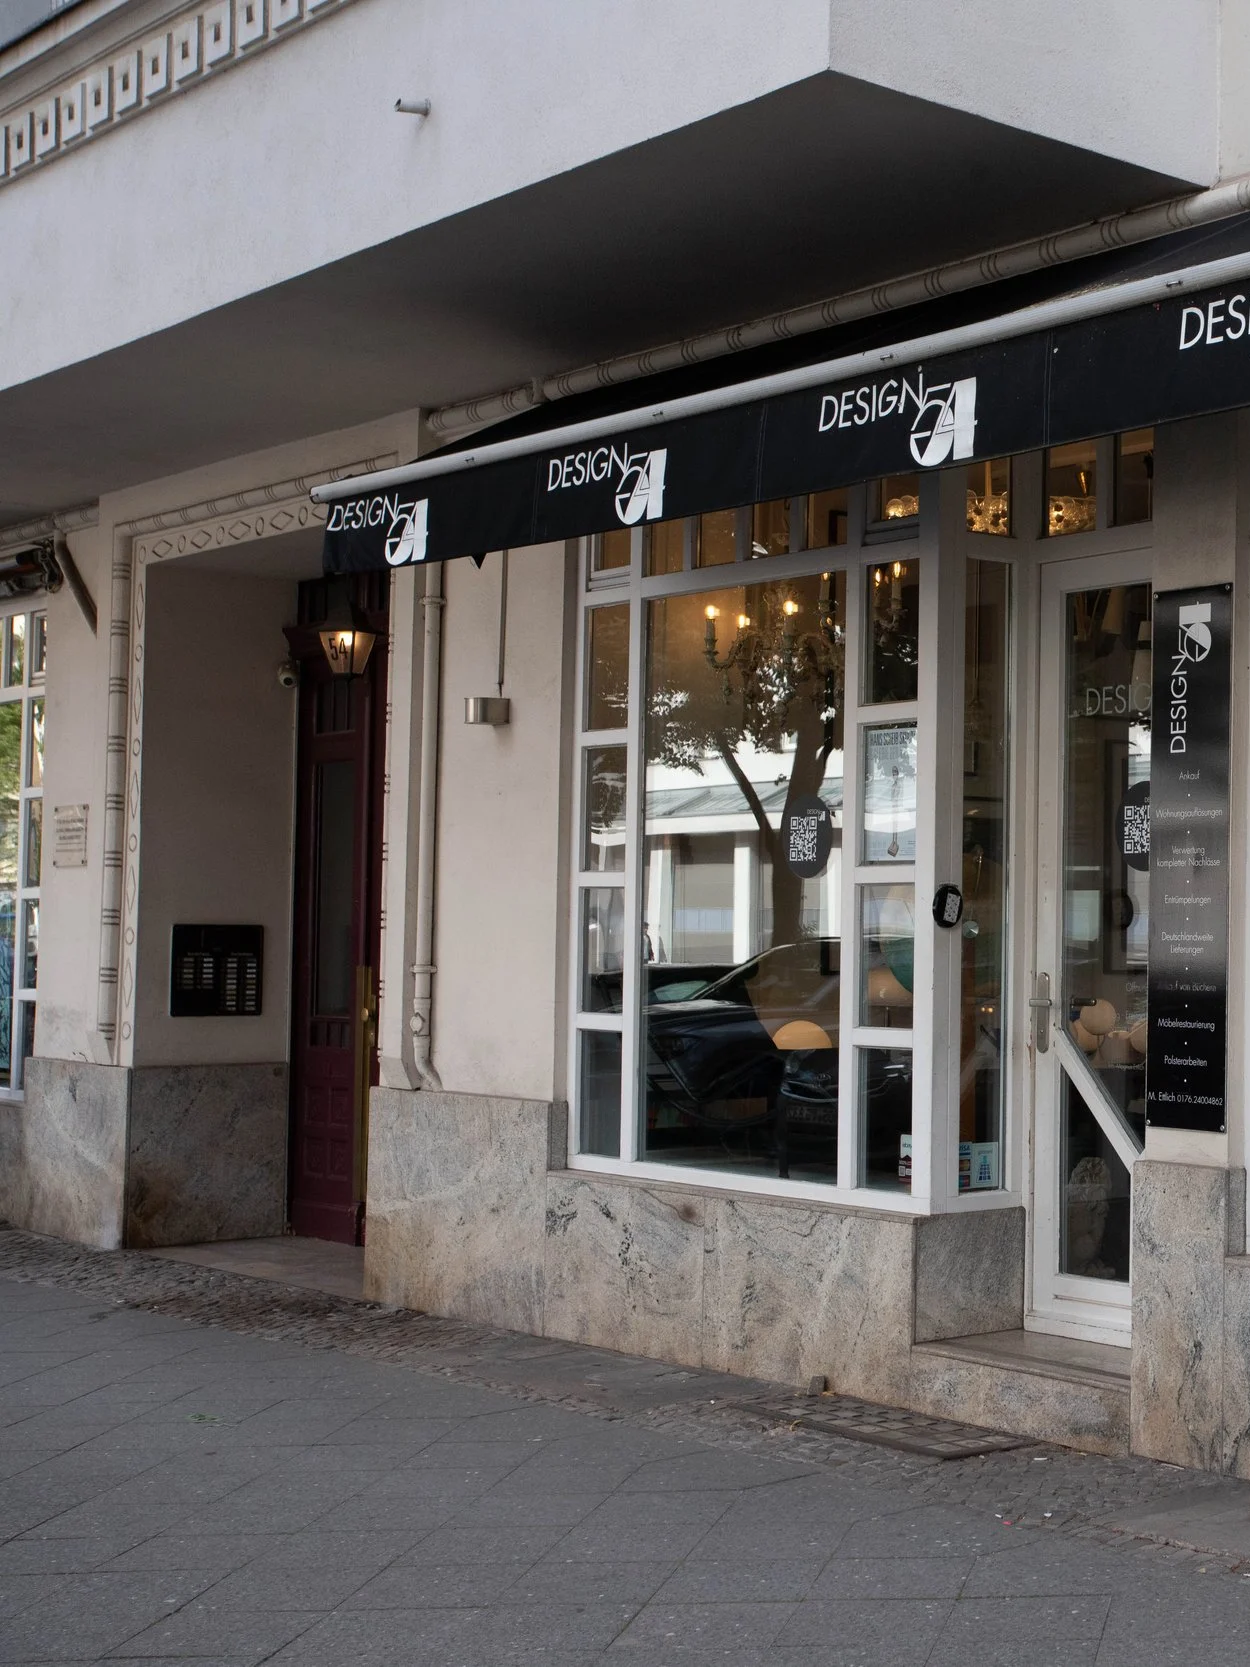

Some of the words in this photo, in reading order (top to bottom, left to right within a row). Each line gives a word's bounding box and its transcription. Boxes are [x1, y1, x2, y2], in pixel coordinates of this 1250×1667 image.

[818, 373, 923, 432] DESIGN
[909, 376, 978, 467] 54
[547, 442, 628, 492] DESIGN
[615, 448, 668, 525] 54
[326, 493, 399, 532] DESIGN
[384, 498, 429, 566] 54
[328, 637, 348, 661] 54
[1170, 655, 1188, 754] DESIGN
[1179, 769, 1200, 780] Ankauf
[1156, 807, 1222, 819] Wohnungsauflösungen
[1172, 846, 1205, 856] Verwertung
[1164, 894, 1212, 906] Entrümpelungen
[1161, 931, 1214, 942] Deutschlandweite
[1170, 945, 1204, 956] Lieferungen
[1157, 1017, 1216, 1032] Möbelrestaurierung
[1164, 1054, 1208, 1067] Polsterarbeiten
[1147, 1091, 1156, 1101] M.
